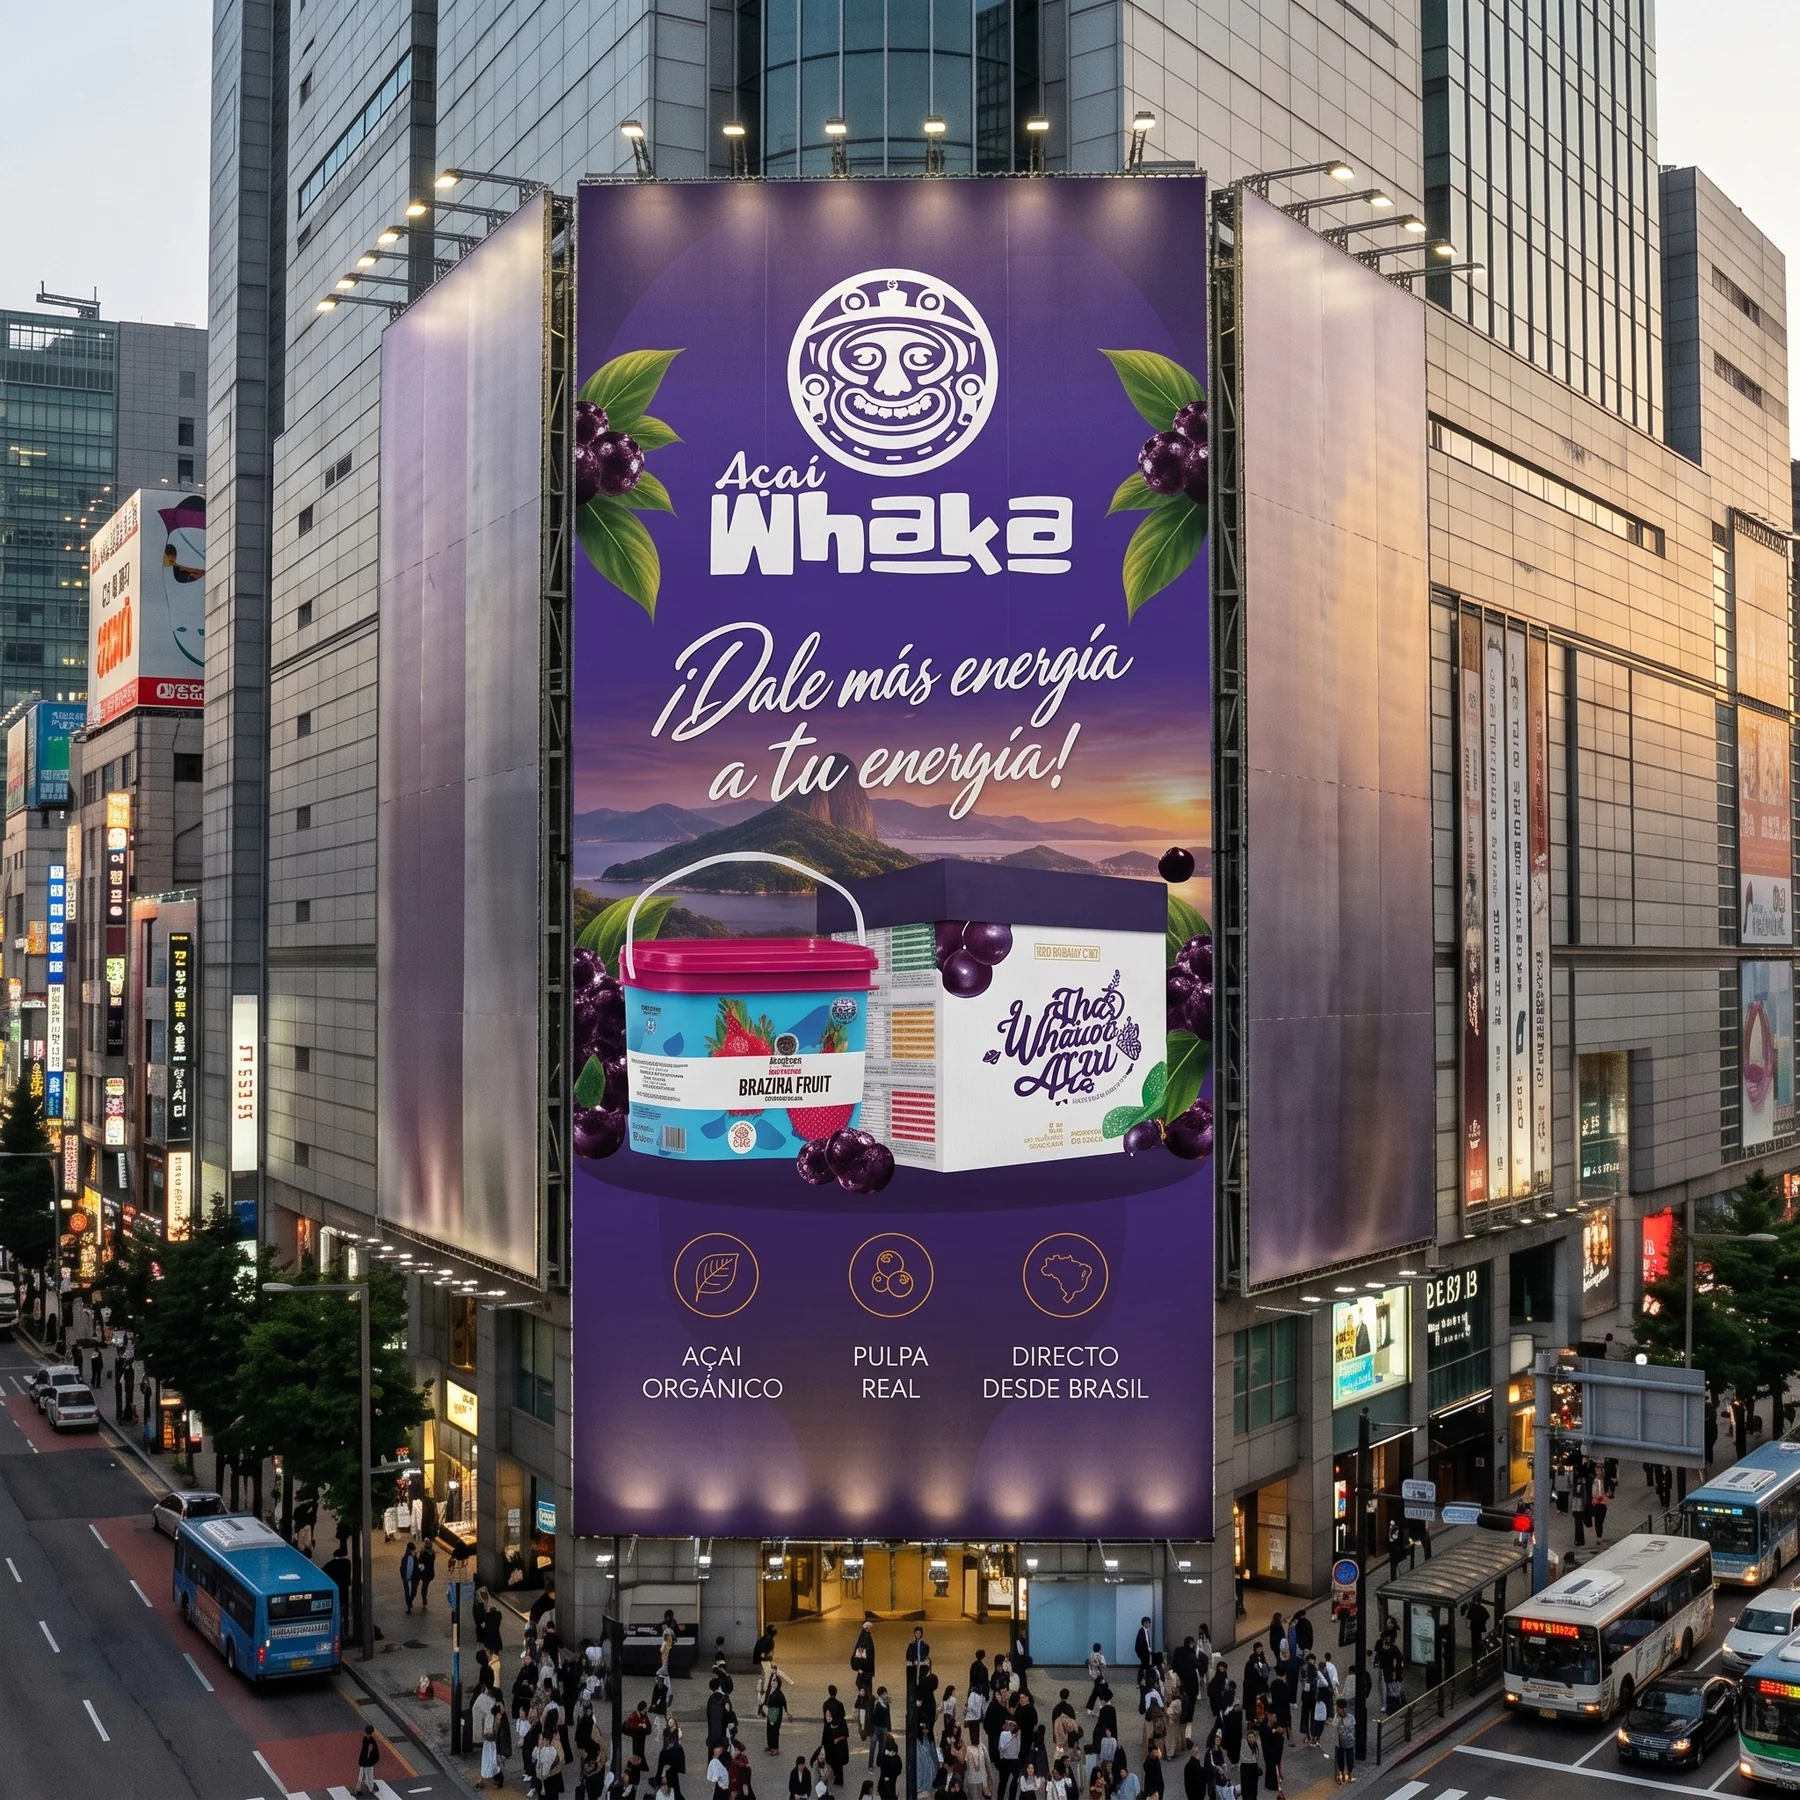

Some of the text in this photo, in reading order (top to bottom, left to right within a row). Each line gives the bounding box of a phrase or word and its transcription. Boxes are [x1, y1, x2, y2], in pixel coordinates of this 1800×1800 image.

[715, 451, 826, 497] Açaí
[710, 491, 1073, 576] Whaka
[651, 621, 1134, 742] ¡Dale más energía
[709, 722, 1081, 820] a tu energía!
[796, 1075, 832, 1094] FRUIT
[682, 1346, 741, 1372] AÇAI
[854, 1346, 929, 1367] PULPA
[1013, 1346, 1119, 1367] DIRECTO
[642, 1374, 783, 1399] ORGÁNICO
[862, 1378, 921, 1399] REAL
[984, 1378, 1149, 1399] DESDE BRASIL
